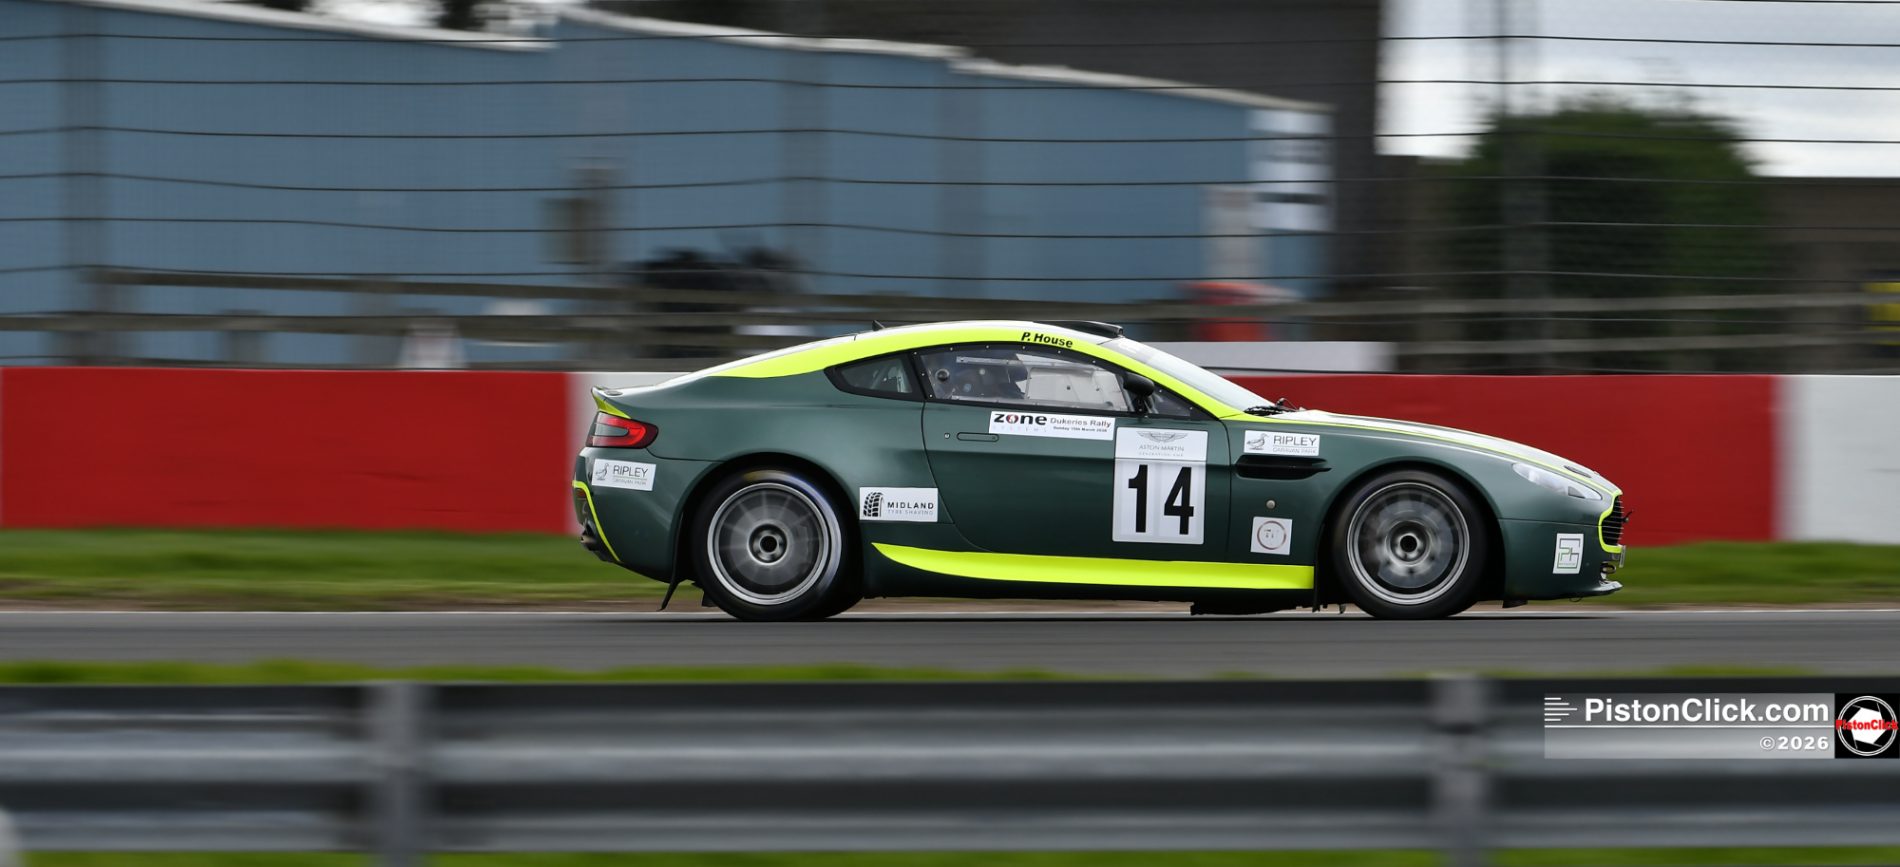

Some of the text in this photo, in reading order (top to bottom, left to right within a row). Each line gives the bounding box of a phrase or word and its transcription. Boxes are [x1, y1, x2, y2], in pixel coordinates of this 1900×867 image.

[1021, 332, 1073, 348] P. House
[993, 413, 1047, 425] zone
[1050, 417, 1112, 429] Dukeries Rally
[1273, 435, 1317, 447] RIPLEY
[613, 464, 649, 478] RIPLEY
[1128, 464, 1194, 535] 14
